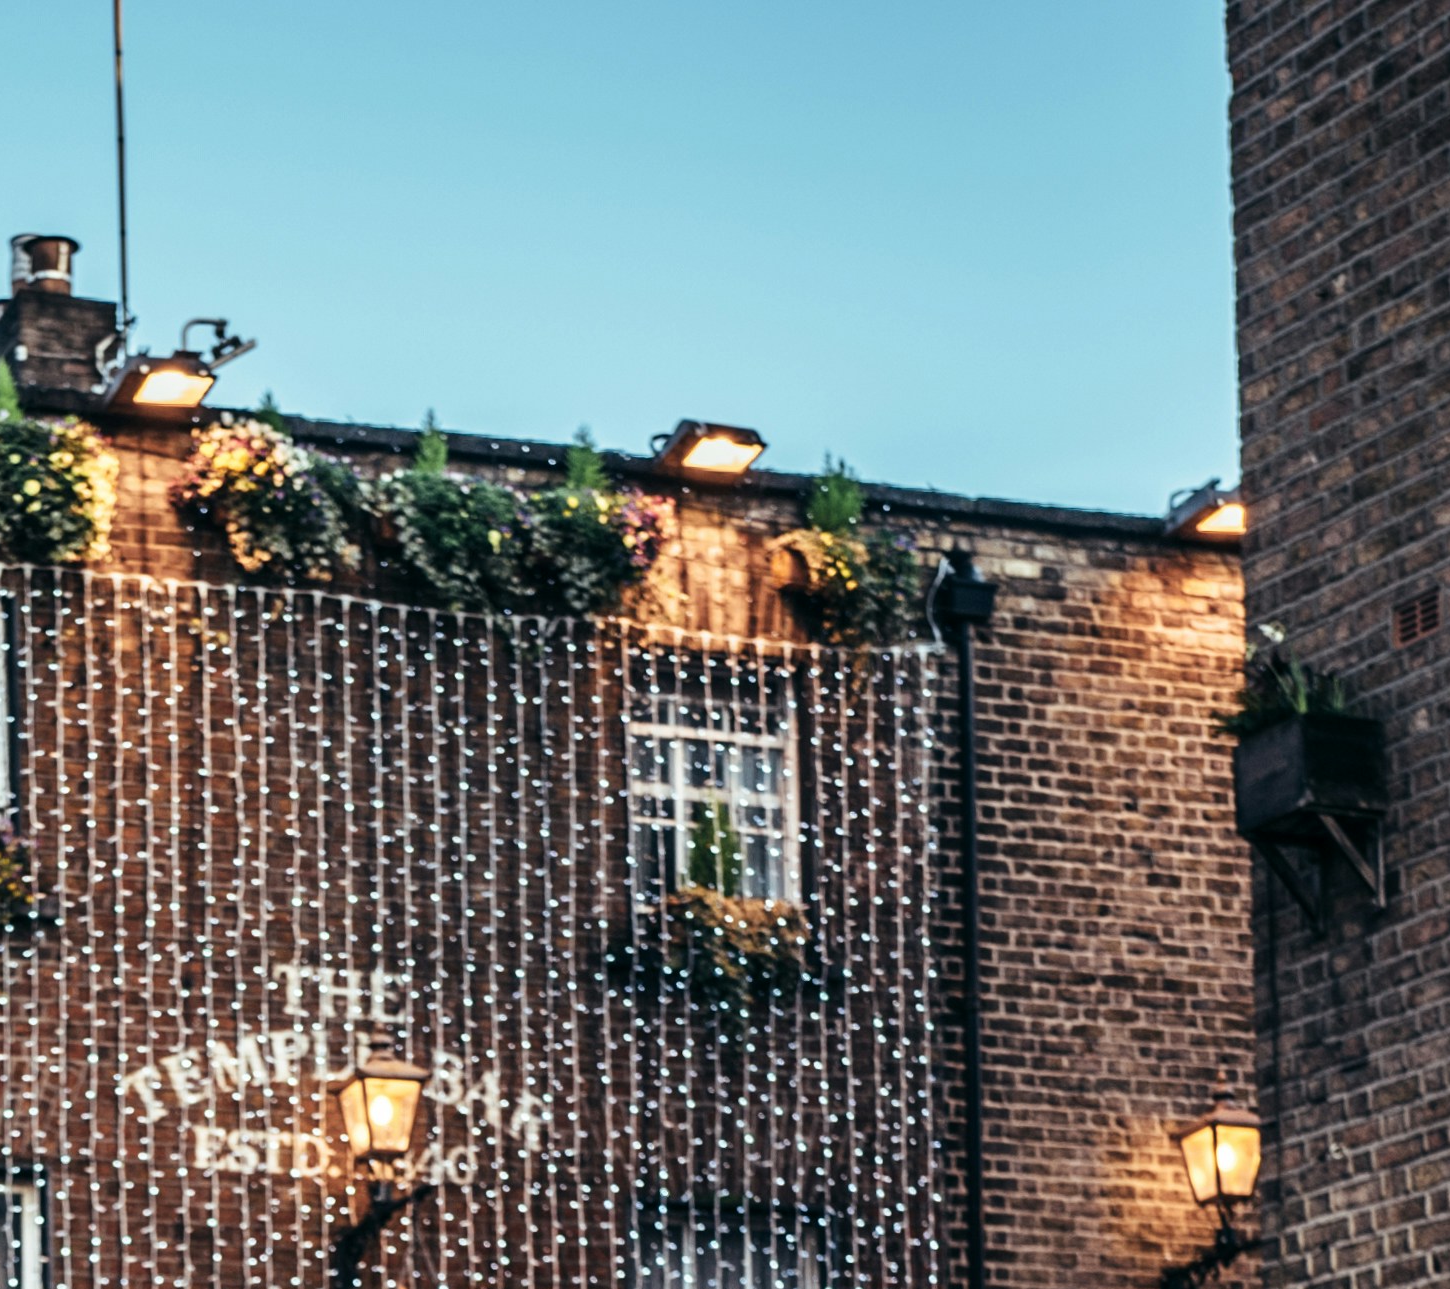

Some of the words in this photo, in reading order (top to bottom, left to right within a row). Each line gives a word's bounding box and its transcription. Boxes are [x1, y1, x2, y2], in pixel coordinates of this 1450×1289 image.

[272, 962, 409, 1023] THE
[123, 1028, 377, 1124] TEMPL
[428, 1048, 548, 1153] BAR
